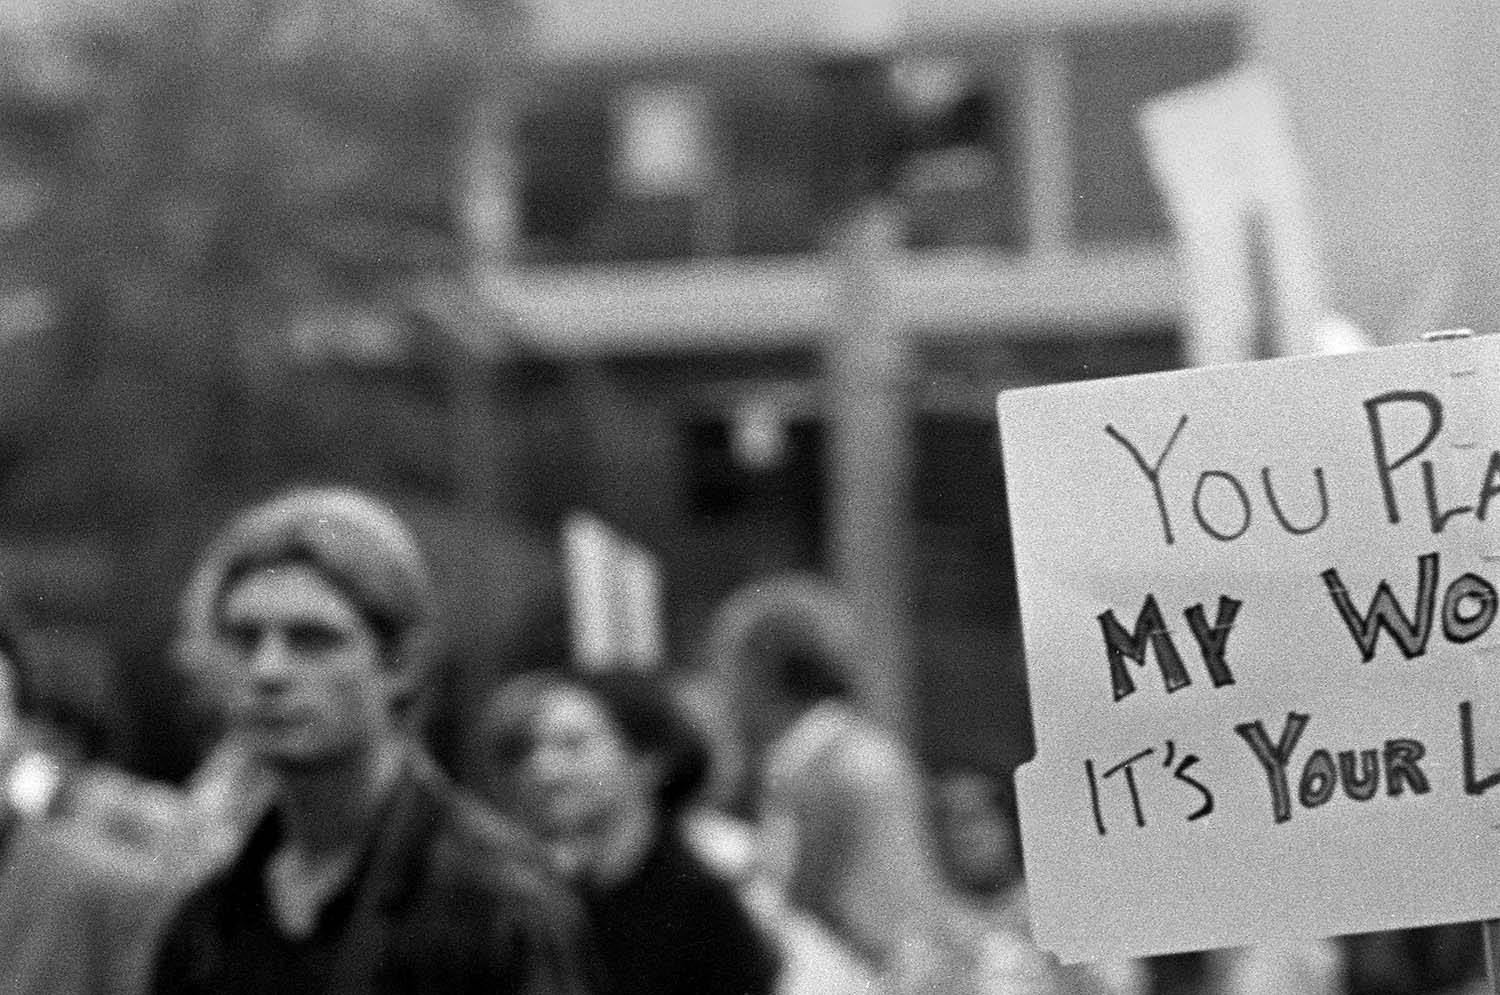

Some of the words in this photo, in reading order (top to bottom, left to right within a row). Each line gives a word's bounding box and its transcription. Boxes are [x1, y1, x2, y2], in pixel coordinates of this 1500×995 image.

[1105, 415, 1329, 545] YOU
[1097, 594, 1242, 701] MY
[1085, 740, 1215, 835] IT'S
[1235, 711, 1431, 824] YOUR
